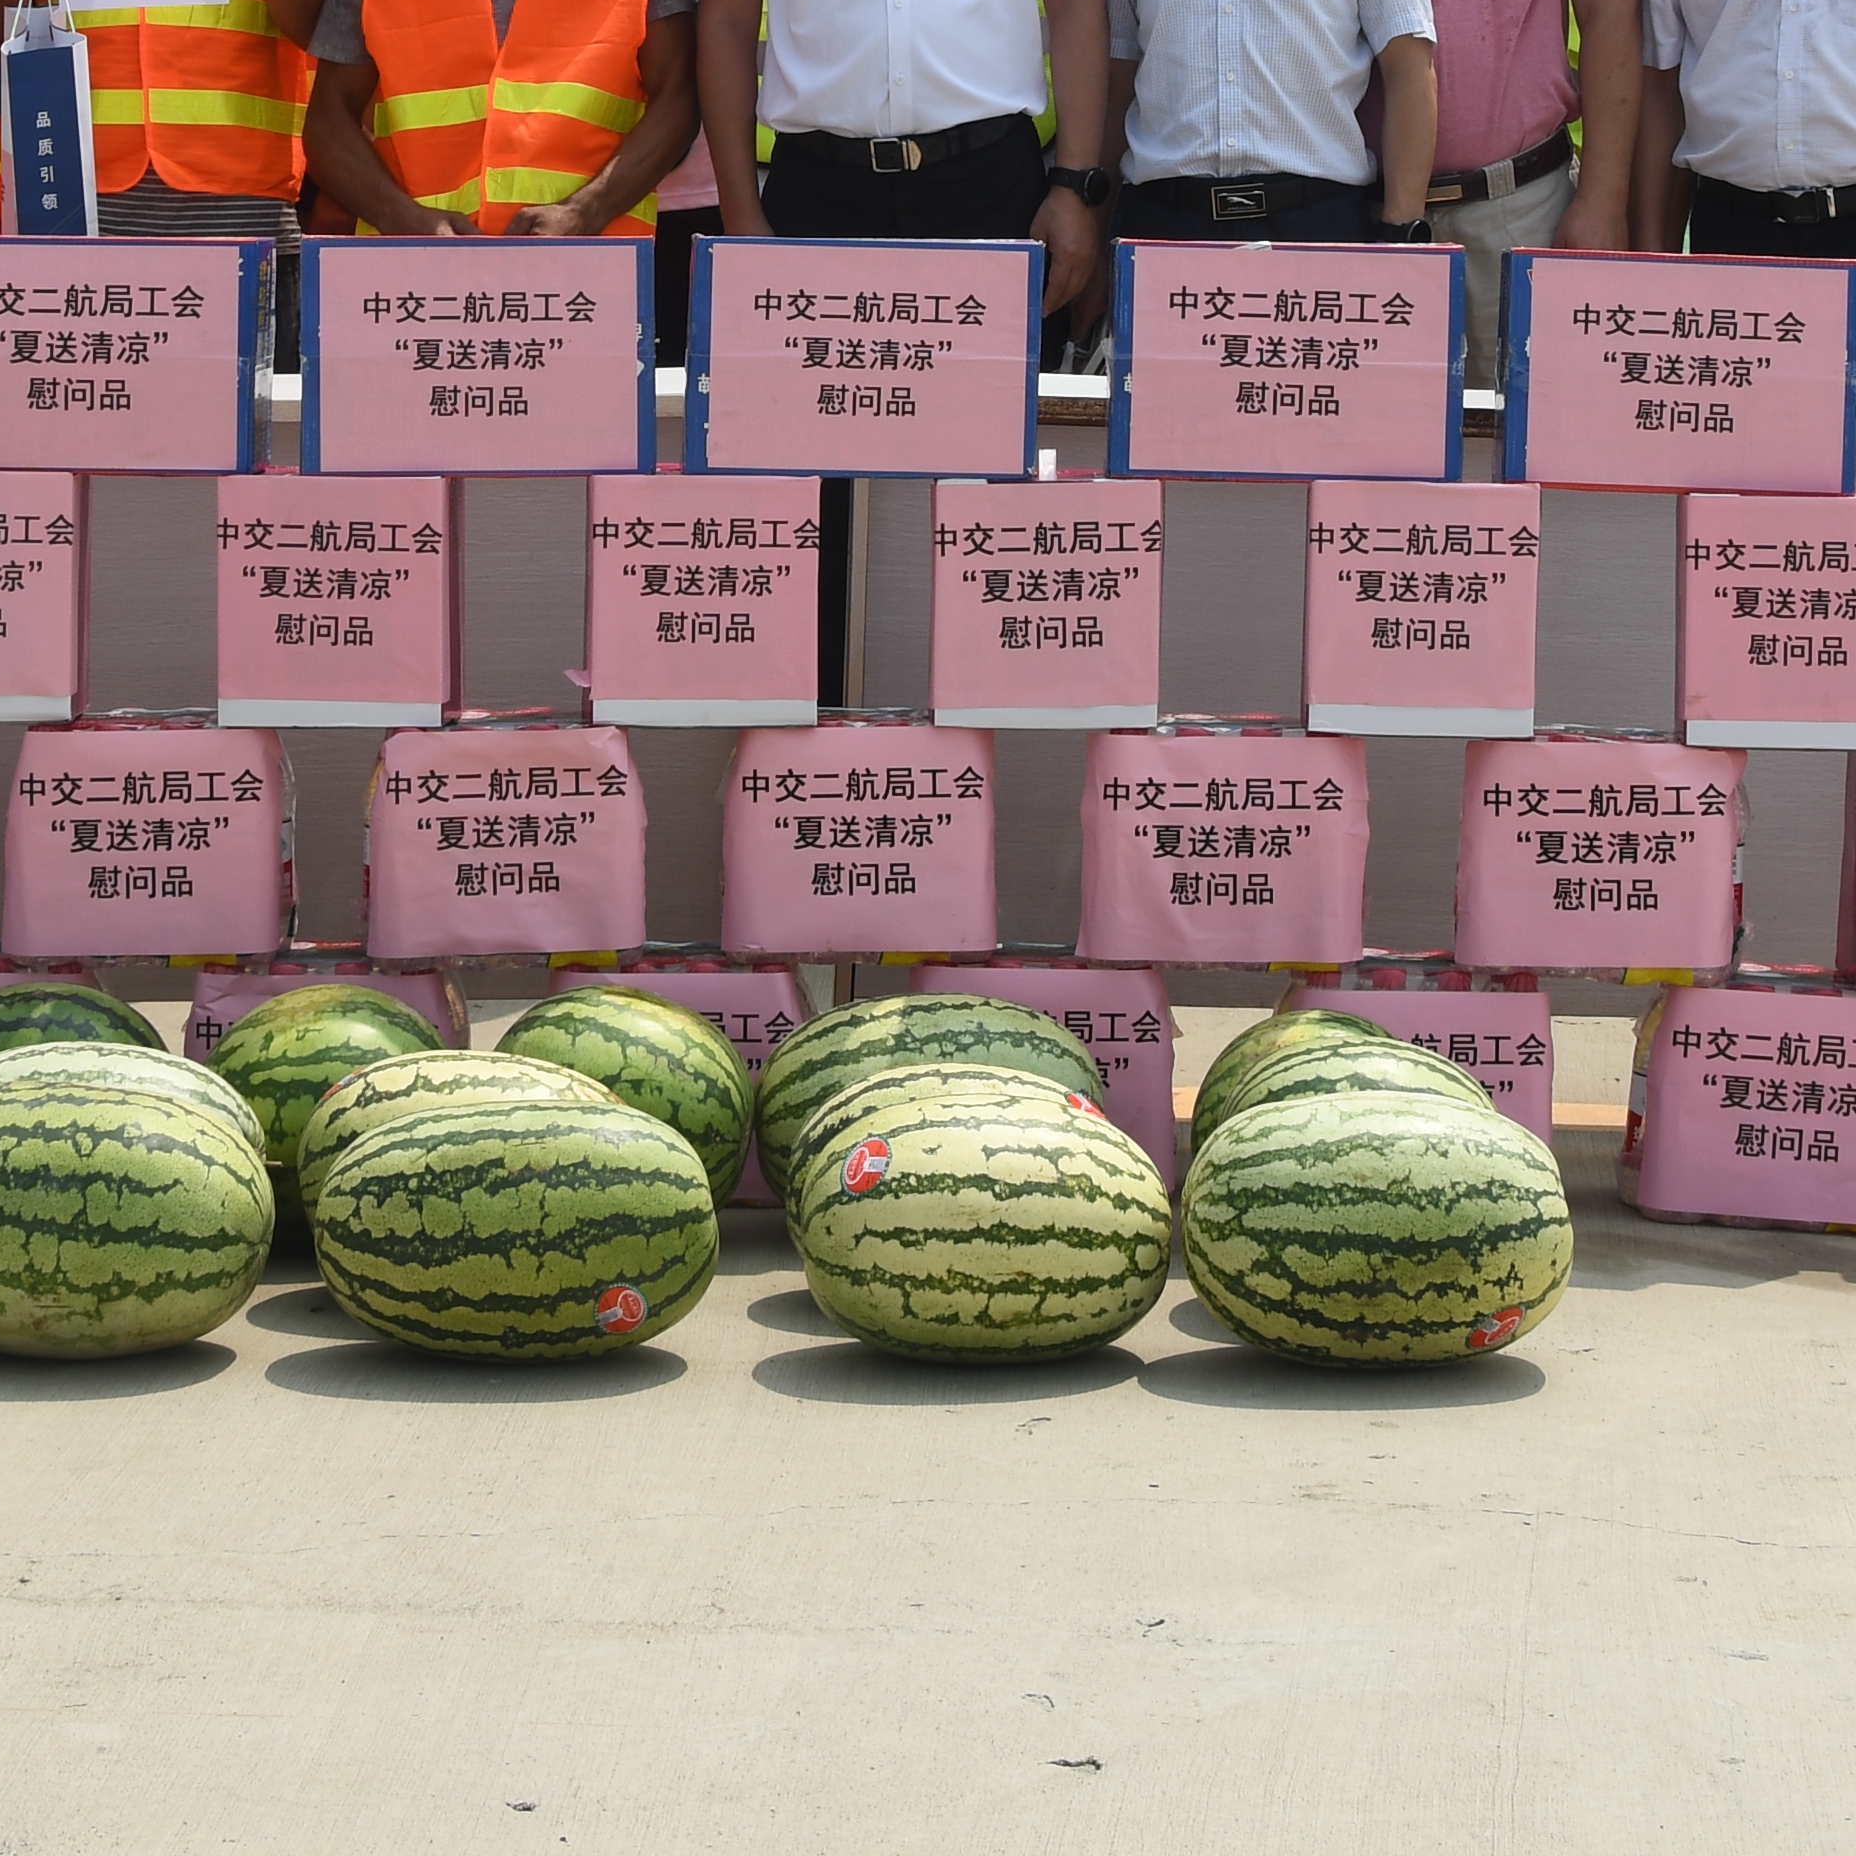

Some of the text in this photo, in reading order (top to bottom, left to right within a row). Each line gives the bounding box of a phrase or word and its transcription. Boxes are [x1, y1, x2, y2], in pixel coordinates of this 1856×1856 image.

[36, 111, 58, 210] 品质引领
[363, 290, 597, 324] 中交二航局工会
[754, 287, 987, 327] 中交二航局工会
[1169, 285, 1415, 327] 中交二航局工会
[1572, 302, 1807, 344] 中交二航局工会
[395, 337, 564, 371] “夏送清凉”
[784, 336, 953, 372] “夏送清凉”
[1201, 333, 1378, 372] “夏送清凉”
[1603, 351, 1771, 389] “夏送清凉”
[26, 376, 131, 412] 慰问品
[428, 384, 529, 418] 慰问品
[816, 383, 916, 417] 慰问品
[1234, 380, 1340, 417] 慰问品
[1634, 399, 1734, 434] 慰问品
[215, 517, 444, 555] 中交二航局工会
[592, 516, 820, 549] 中交二航局工会
[1309, 523, 1539, 560] 中交二航局工会
[242, 565, 409, 601] “夏送清凉”
[622, 564, 791, 598] “夏送清凉”
[962, 566, 1139, 604] “夏送清凉”
[1338, 569, 1506, 605] “夏送清凉”
[274, 612, 374, 647] 慰问品
[655, 610, 755, 644] 慰问品
[998, 615, 1104, 650] 慰问品
[1370, 616, 1470, 651] 慰问品
[1747, 633, 1848, 667] 慰问品
[19, 768, 264, 807] 中交二航局工会
[385, 764, 628, 805] 中交二航局工会
[741, 765, 985, 804] 中交二航局工会
[1102, 776, 1344, 812] 中交二航局工会
[1483, 782, 1728, 818] 中交二航局工会
[51, 816, 229, 854] “夏送清凉”
[417, 811, 595, 852] “夏送清凉”
[774, 813, 952, 850] “夏送清凉”
[1134, 824, 1311, 859] “夏送清凉”
[1516, 830, 1695, 865] “夏送清凉”
[87, 864, 193, 900] 慰问品
[454, 861, 560, 897] 慰问品
[810, 861, 916, 897] 慰问品
[1169, 871, 1274, 907] 慰问品
[1552, 876, 1659, 912] 慰问品
[1734, 1123, 1840, 1163] 慰问品
